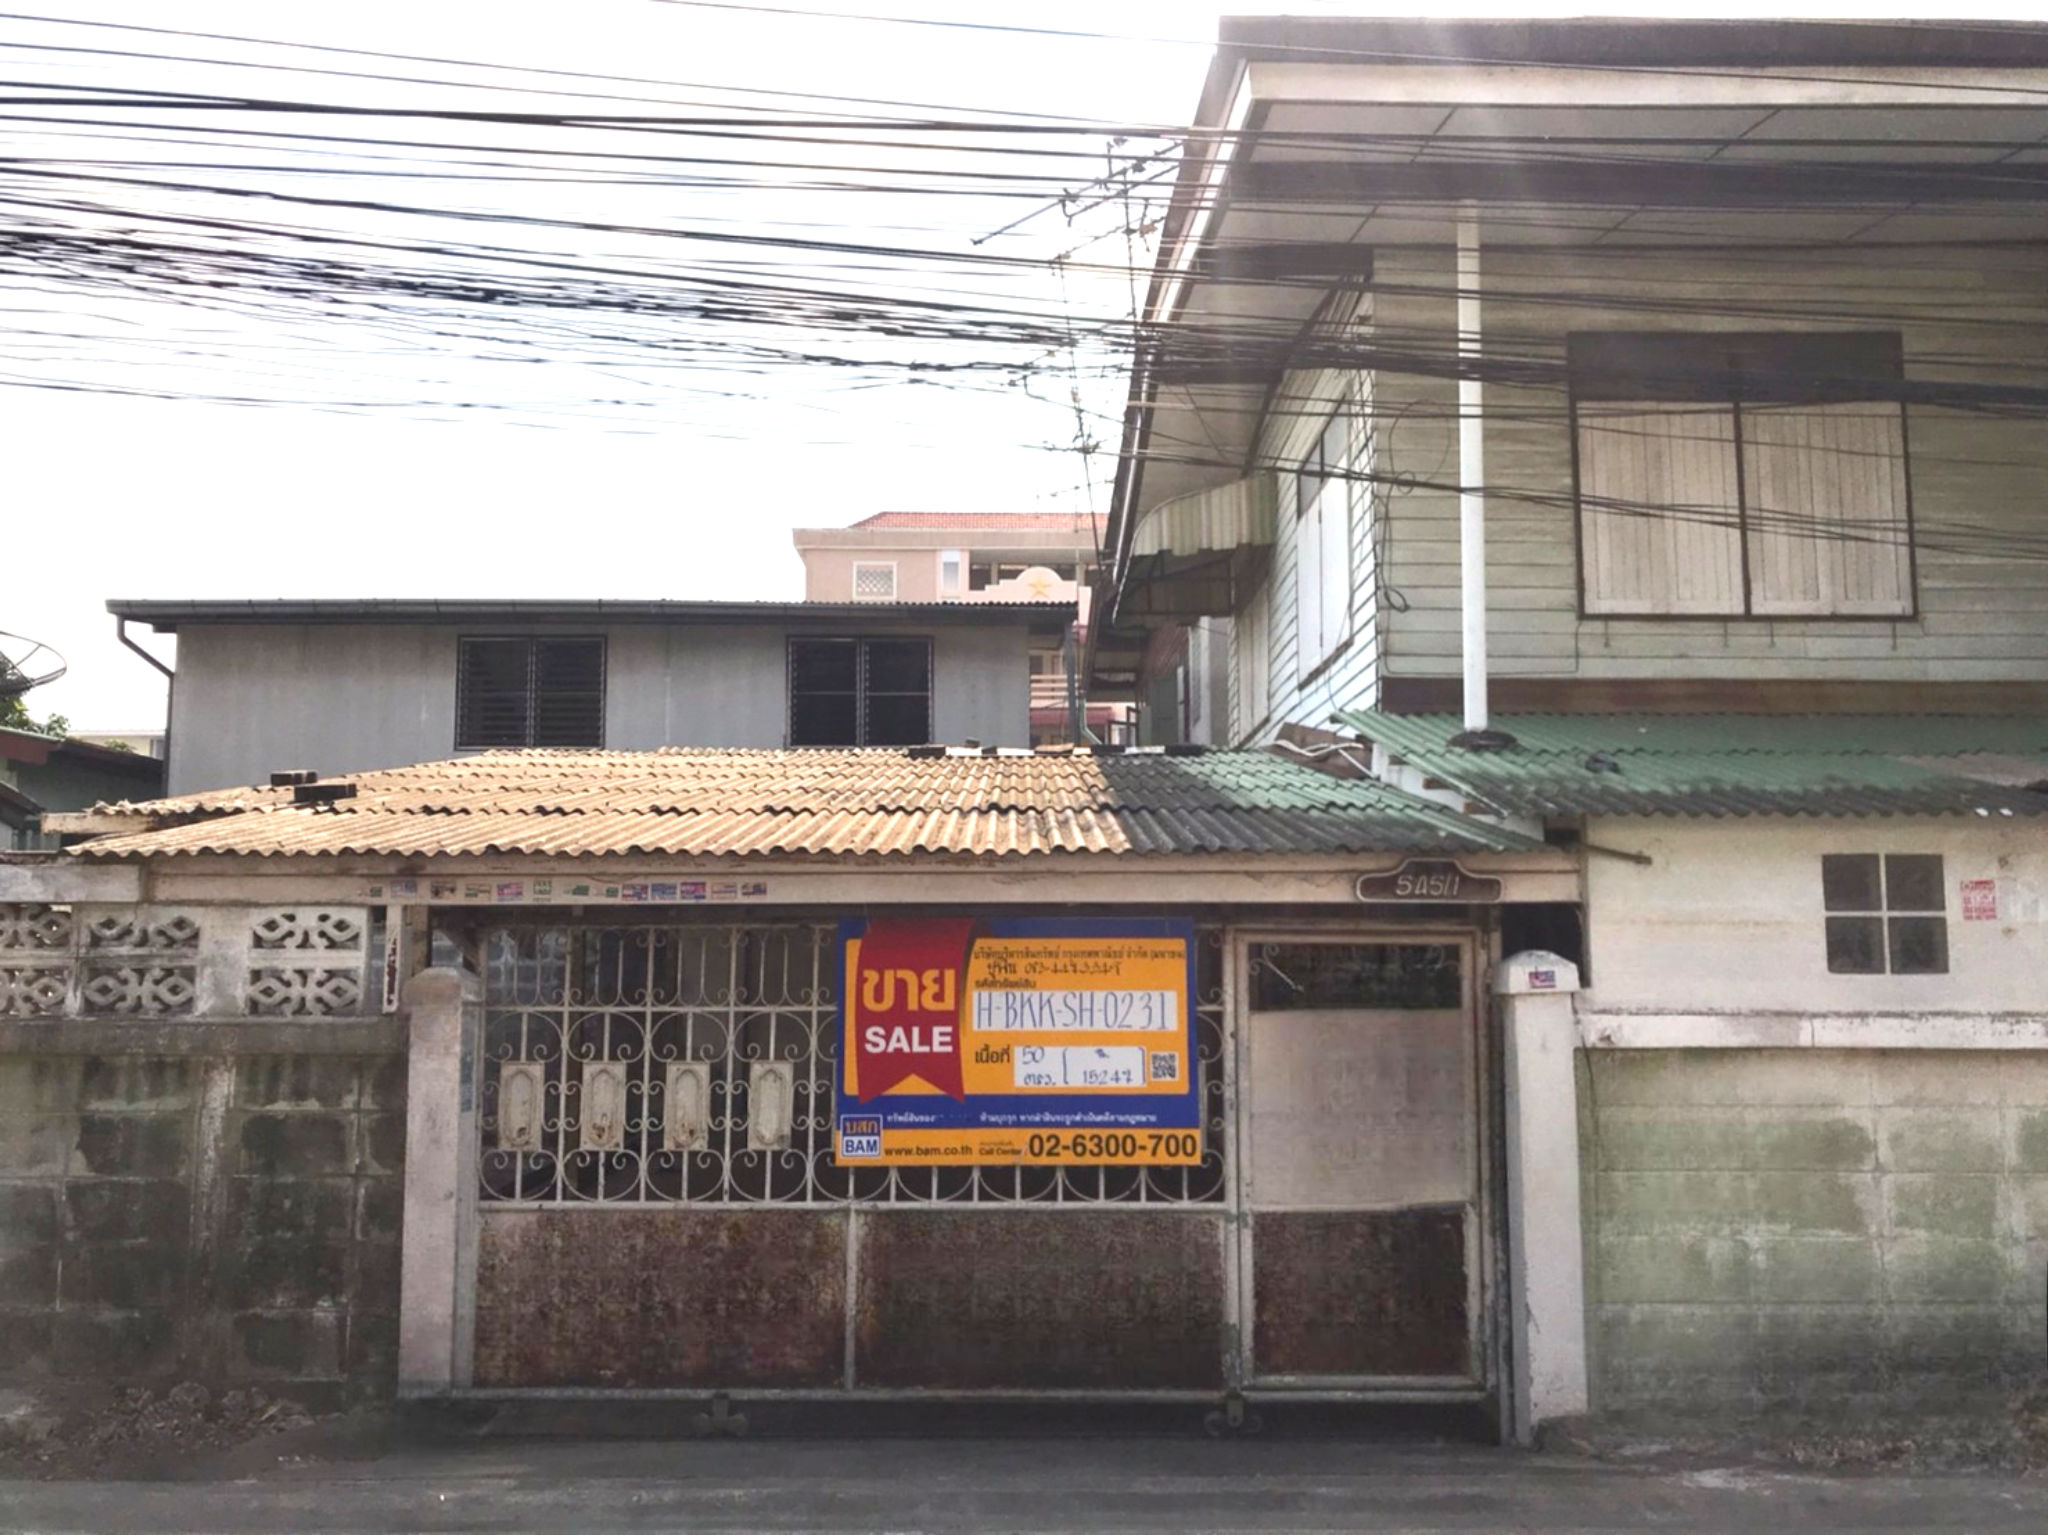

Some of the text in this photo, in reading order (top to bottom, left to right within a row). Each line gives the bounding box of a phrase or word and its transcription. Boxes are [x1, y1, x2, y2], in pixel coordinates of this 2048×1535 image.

[863, 968, 956, 1012] ขาย
[977, 991, 1169, 1030] H-BKK-SH-0231
[865, 1025, 953, 1054] SALE
[975, 1043, 1011, 1064] เนื้อที่
[1022, 1046, 1045, 1065] 50
[845, 1138, 878, 1154] BAM
[884, 1144, 973, 1156] www.bam.co.th
[1028, 1133, 1198, 1158] 02-6300-700
